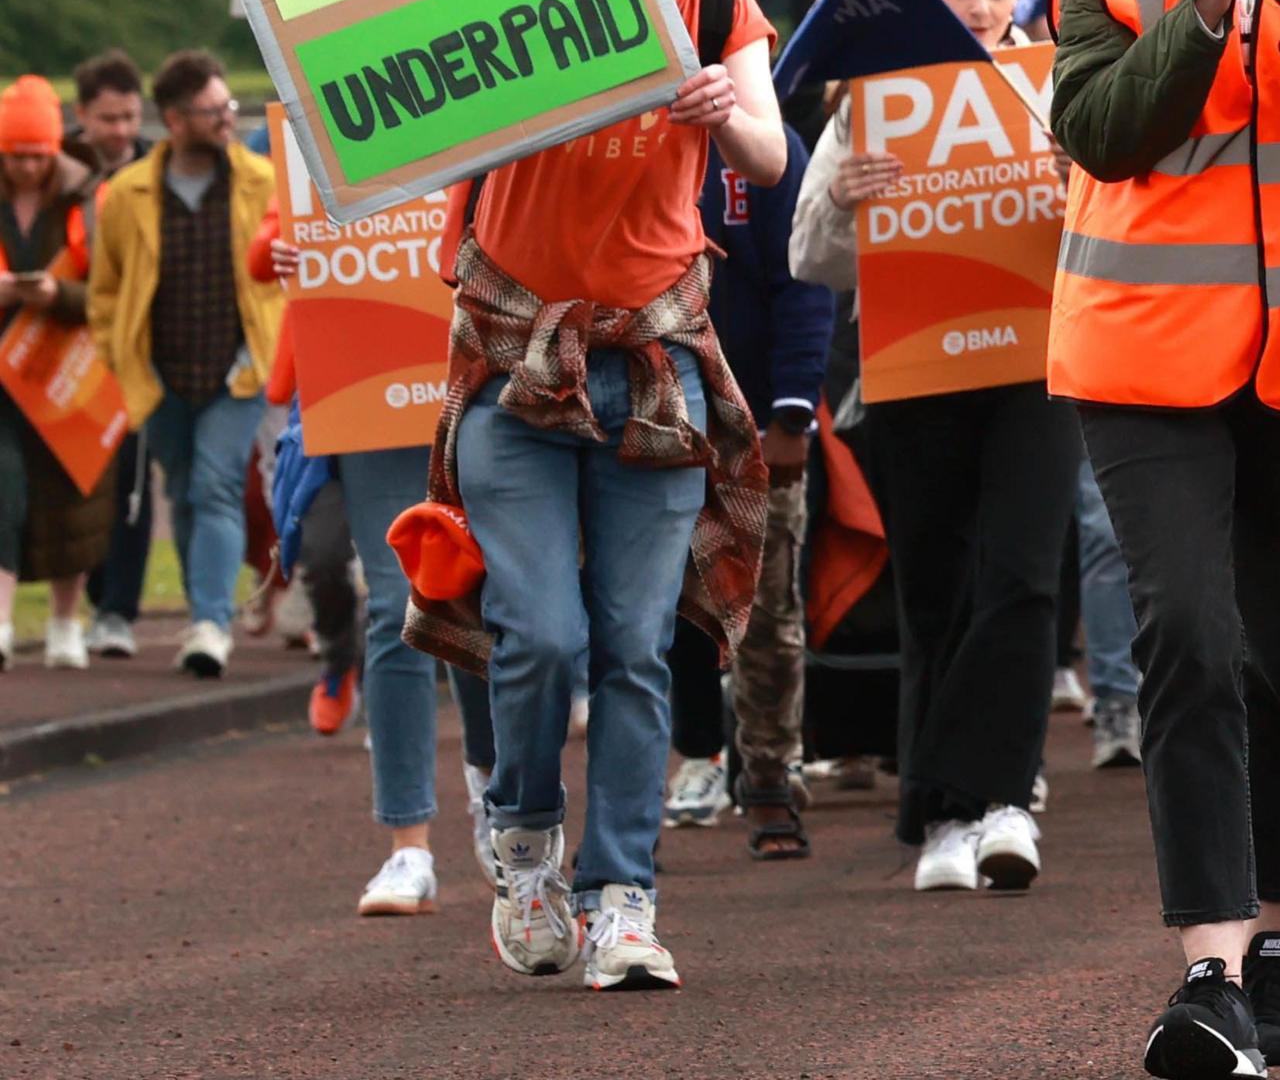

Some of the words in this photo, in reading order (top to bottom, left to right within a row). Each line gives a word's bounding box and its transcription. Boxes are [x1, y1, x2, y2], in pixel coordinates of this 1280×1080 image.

[864, 62, 1054, 168] PAY
[565, 133, 668, 158] VIBE
[292, 208, 447, 243] RESTORATIO
[299, 235, 442, 289] DOCT
[966, 326, 1018, 351] BMA
[411, 380, 447, 405] BM
